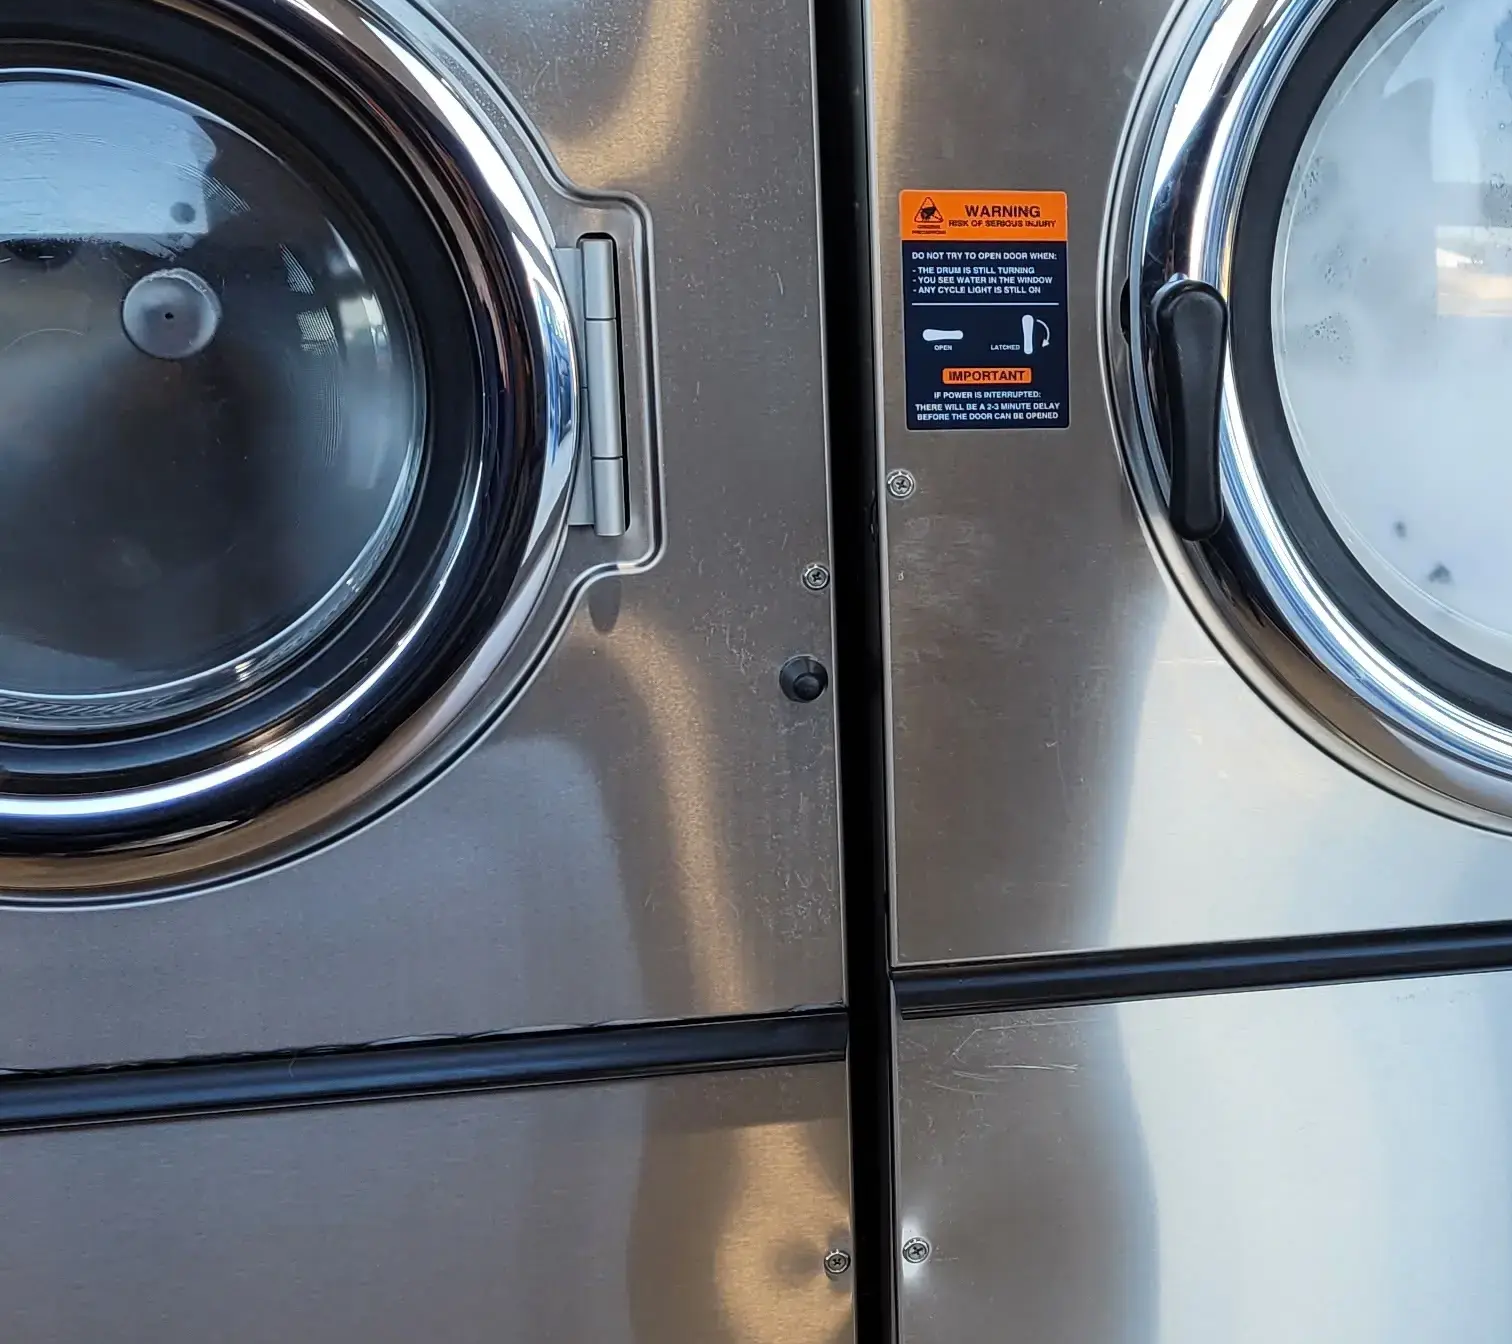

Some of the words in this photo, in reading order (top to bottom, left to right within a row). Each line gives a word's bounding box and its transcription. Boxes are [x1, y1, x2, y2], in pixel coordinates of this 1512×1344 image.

[965, 205, 1041, 218] WARNING
[946, 252, 962, 260] TRY
[964, 252, 976, 260] TO
[978, 252, 1001, 260] OPEN
[1003, 252, 1028, 260] DOOR
[1030, 252, 1057, 260] WHEN:
[949, 370, 1025, 381] IMPORTANT
